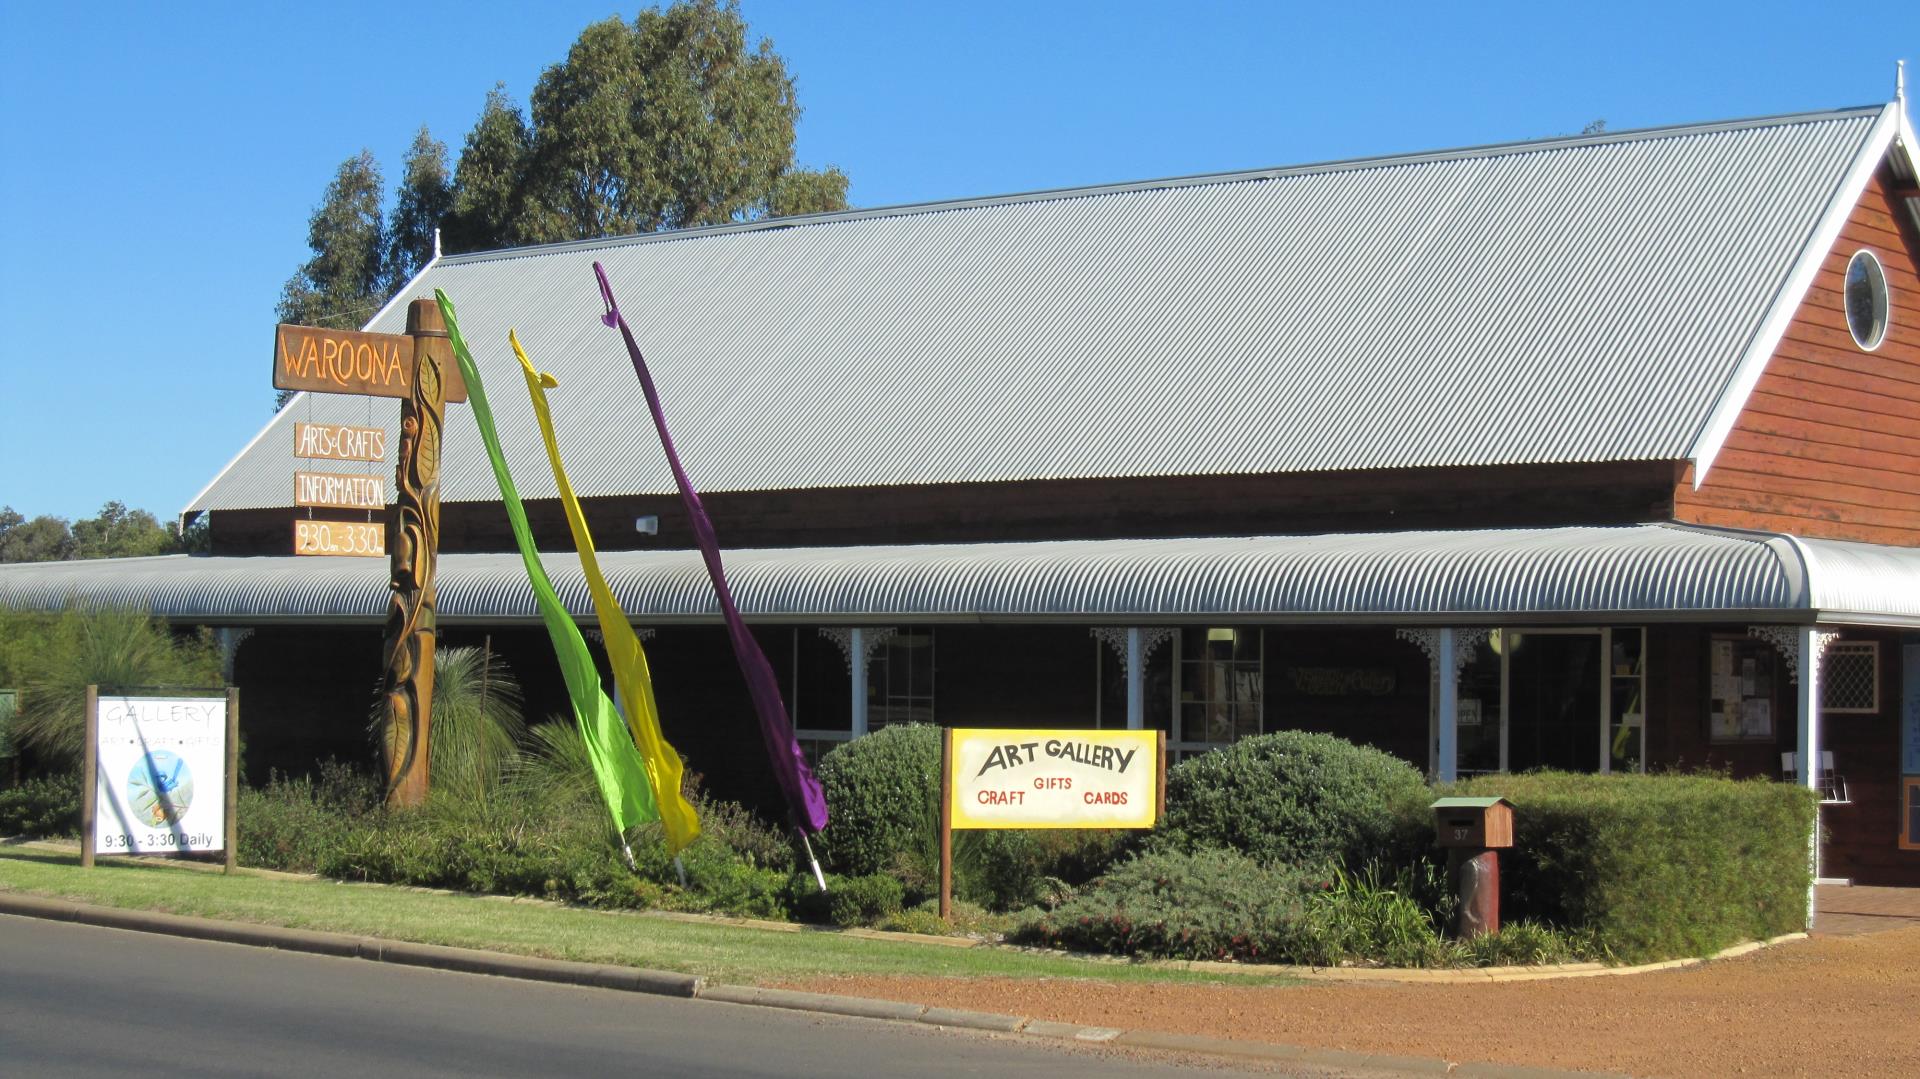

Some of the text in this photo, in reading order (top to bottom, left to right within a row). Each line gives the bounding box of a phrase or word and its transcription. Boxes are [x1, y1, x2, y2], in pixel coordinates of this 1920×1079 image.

[281, 335, 406, 386] WAROONA
[299, 475, 384, 507] INFORMATION
[106, 705, 216, 728] GALLERY
[972, 739, 1139, 782] ART GALLERY
[1033, 777, 1072, 790] GIFTS
[977, 790, 1026, 805] CRAFT
[1083, 791, 1129, 806] CARDS
[105, 834, 135, 848] 9:30
[147, 833, 176, 847] 3:30
[180, 832, 213, 848] Daily
[1453, 828, 1469, 841] 37
